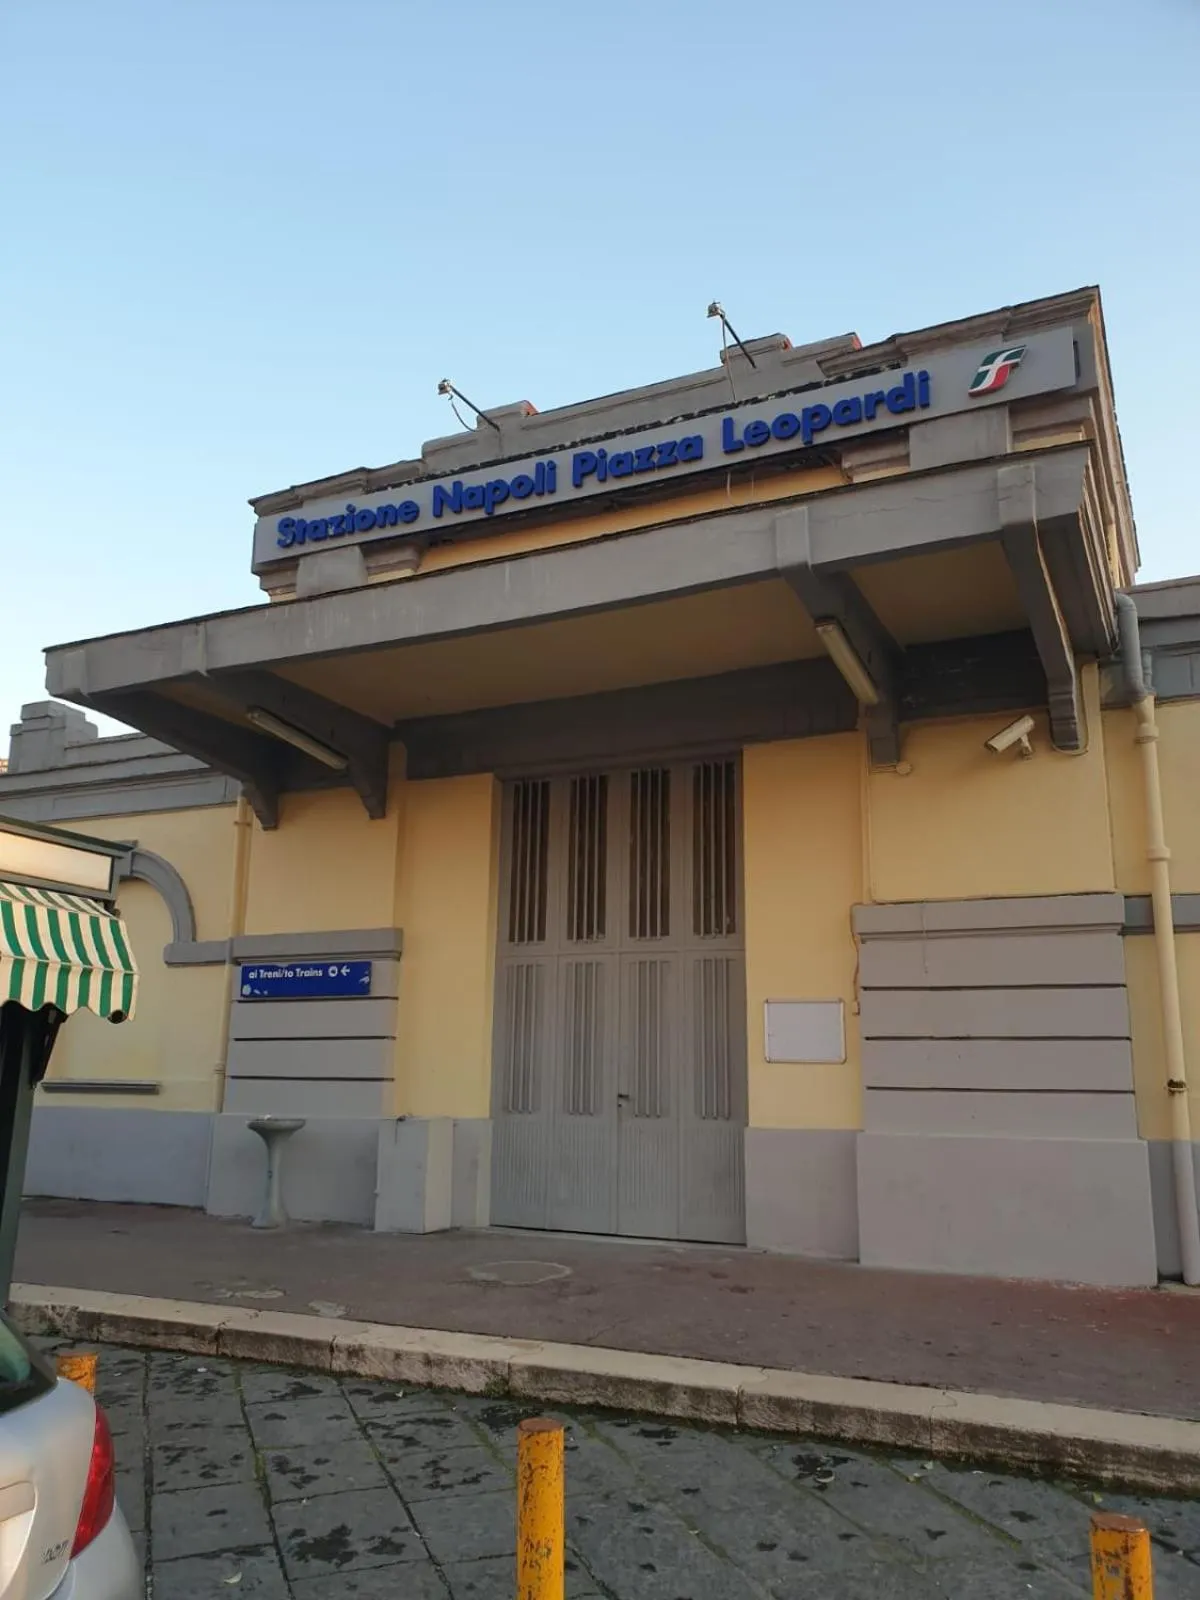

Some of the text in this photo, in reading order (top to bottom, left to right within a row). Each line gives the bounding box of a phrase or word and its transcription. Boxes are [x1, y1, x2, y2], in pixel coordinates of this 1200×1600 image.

[277, 372, 930, 547] Stazione Napoli Piazza Leopardi
[296, 968, 323, 978] Trains
